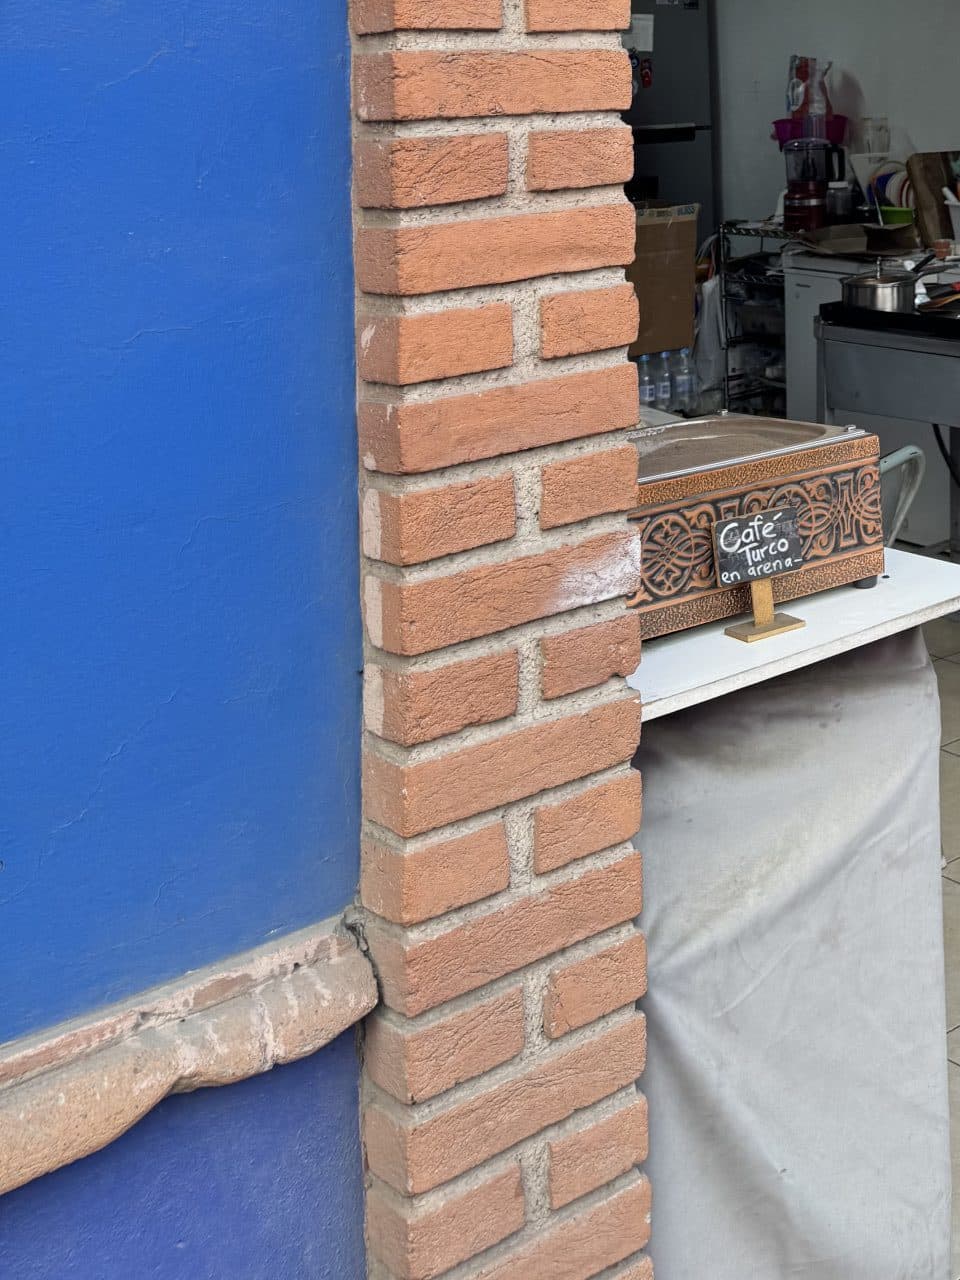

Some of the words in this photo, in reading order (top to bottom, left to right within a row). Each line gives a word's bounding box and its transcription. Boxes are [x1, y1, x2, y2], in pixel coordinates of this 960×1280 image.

[719, 511, 783, 553] Café
[737, 538, 789, 566] Turco
[721, 571, 741, 584] en
